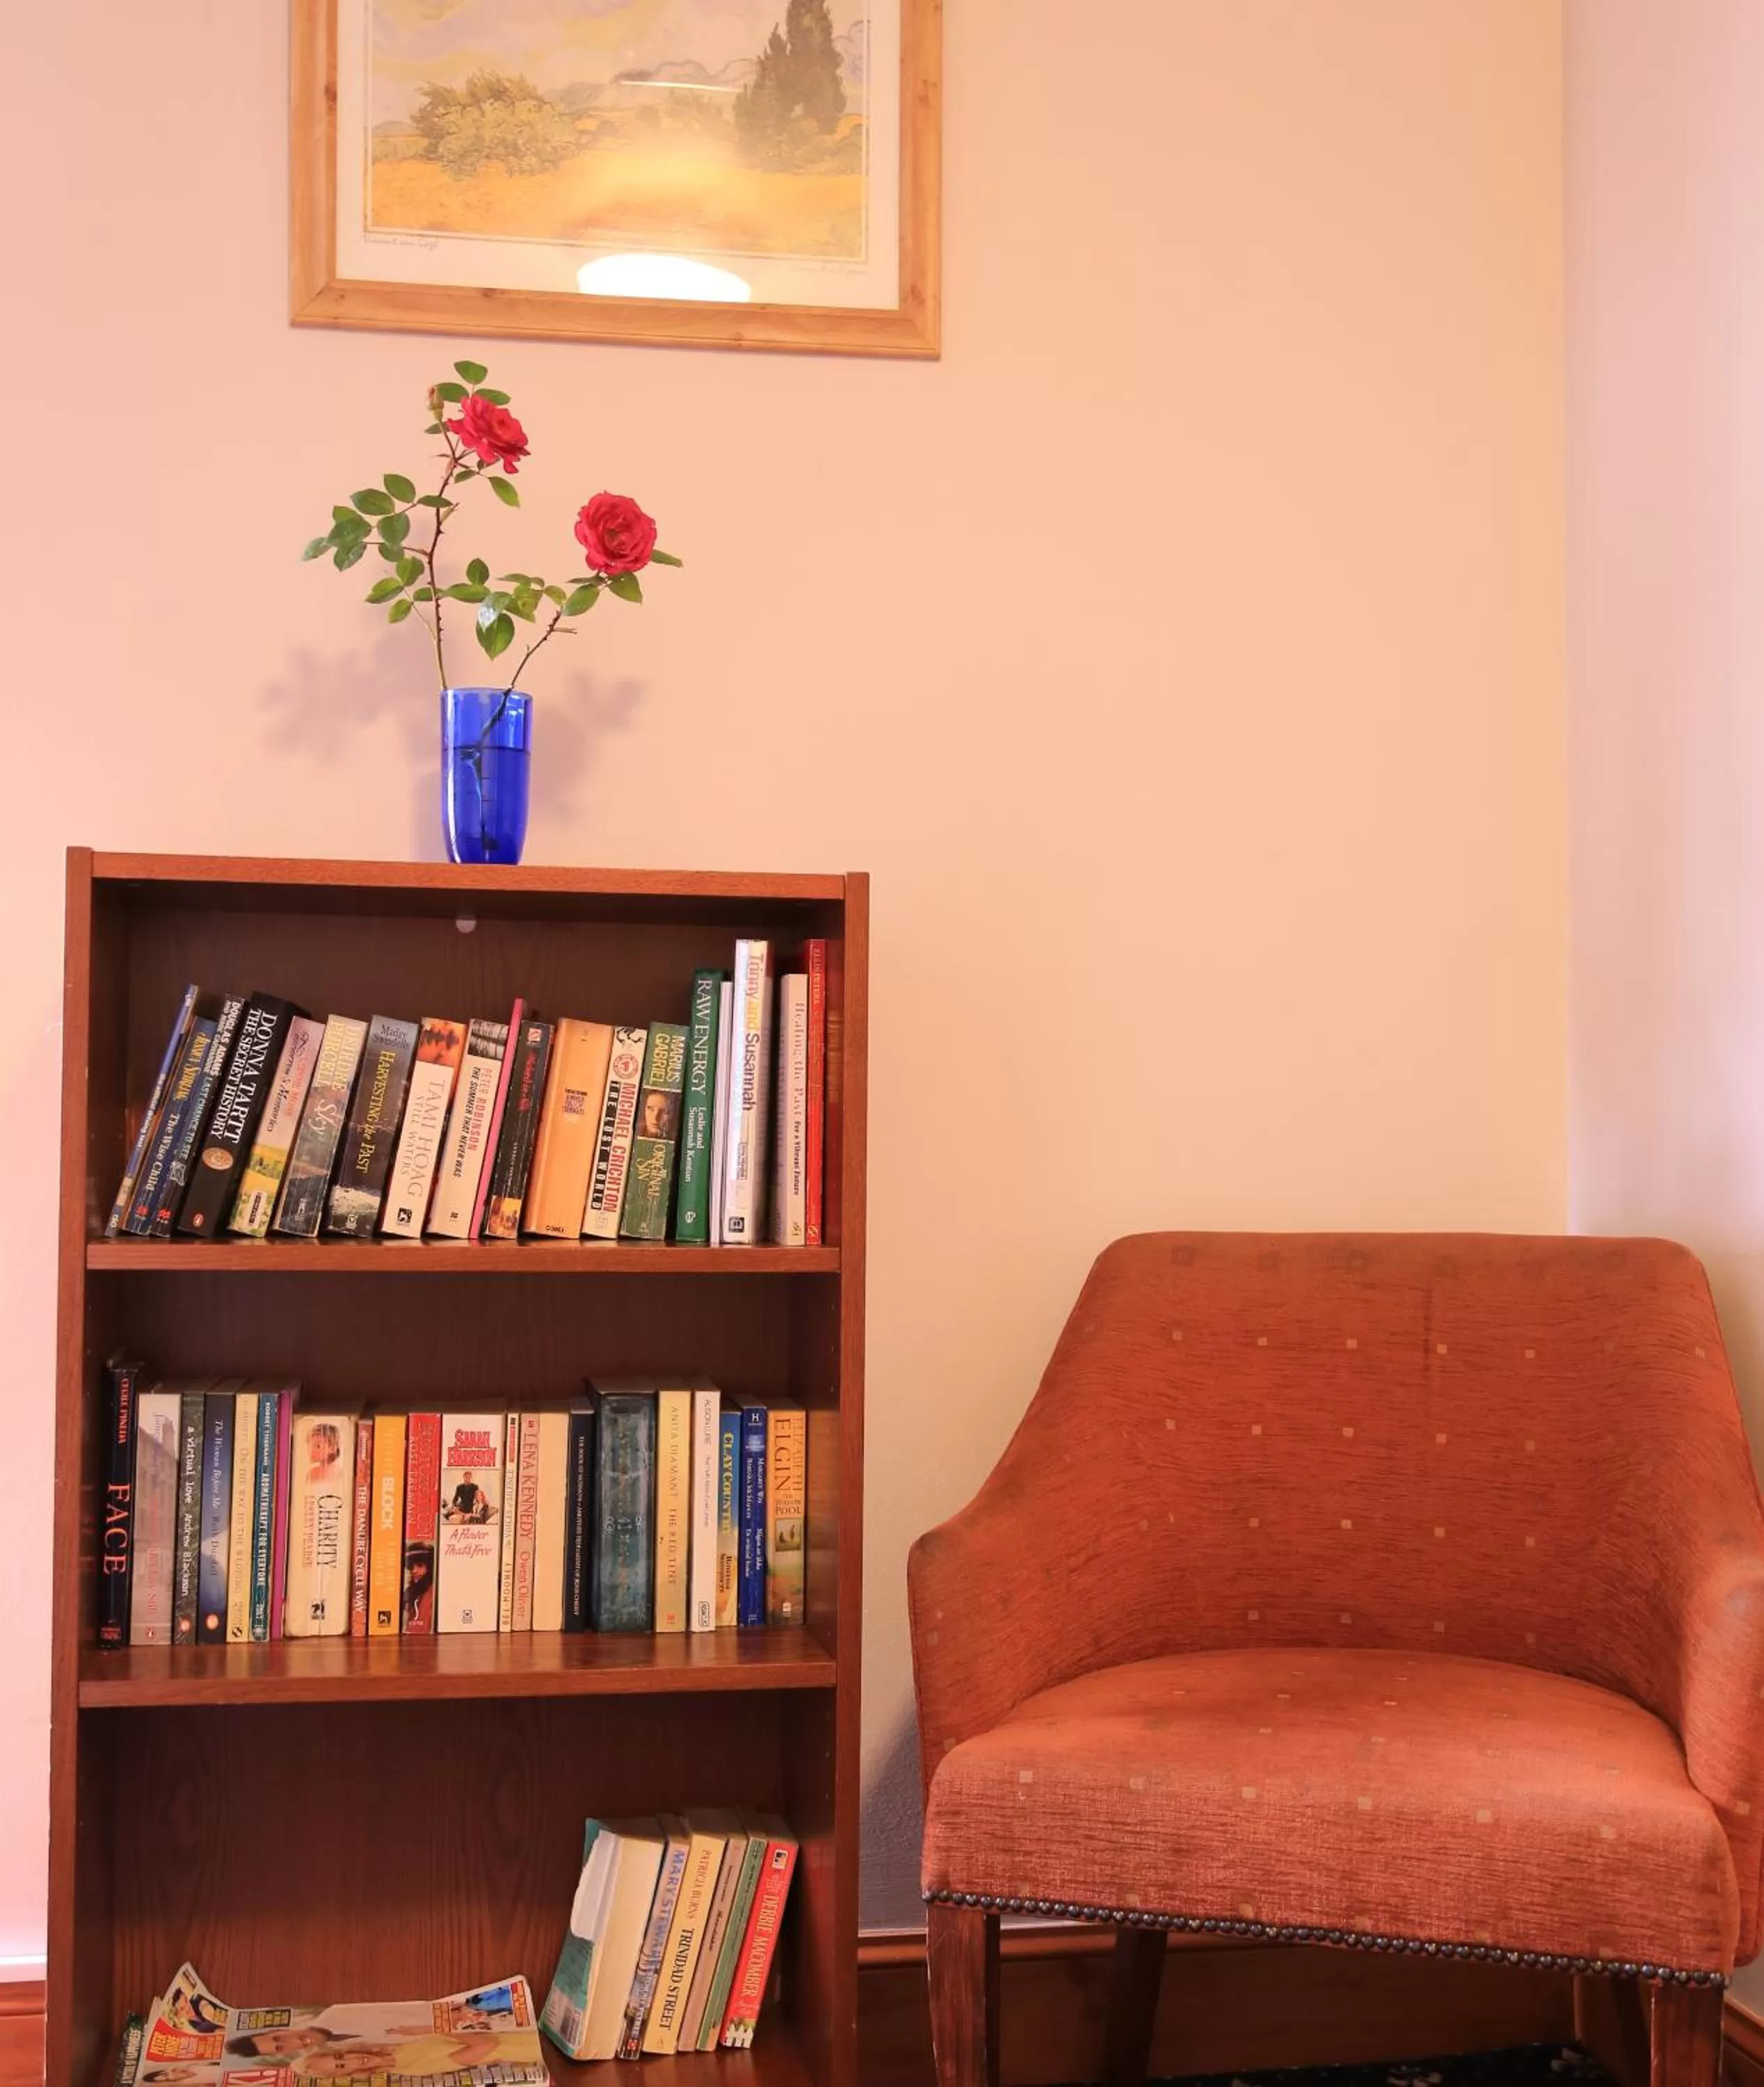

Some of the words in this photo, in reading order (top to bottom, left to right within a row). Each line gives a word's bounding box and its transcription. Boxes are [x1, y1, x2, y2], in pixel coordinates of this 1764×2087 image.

[746, 954, 765, 1000] Trinny
[697, 979, 714, 1017] RAW
[220, 1001, 241, 1044] DOUGLAS
[247, 1008, 262, 1036] THE
[745, 1000, 761, 1031] and
[793, 1002, 805, 1057] Healing
[210, 1045, 227, 1076] ADAMS
[227, 1034, 253, 1085] SECRET
[243, 1011, 278, 1077] DONNA
[314, 1020, 346, 1089] PURCELL
[332, 1025, 360, 1092] DEIRDRE
[650, 1032, 671, 1087] GABRIEL
[666, 1034, 686, 1083] MARIUS
[691, 1022, 711, 1097] ENERGY
[200, 1076, 212, 1097] LAST
[368, 1050, 396, 1125] HARVESTING
[472, 1066, 481, 1081] THE
[480, 1067, 493, 1098] PETER
[741, 1032, 760, 1112] Susannah
[794, 1060, 805, 1082] the
[211, 1085, 236, 1140] HISTORY
[223, 1082, 257, 1144] TARTT
[266, 1083, 291, 1133] Memories
[410, 1096, 424, 1125] STILL
[422, 1079, 447, 1130] TAMI
[465, 1082, 479, 1114] SUMMER
[607, 1080, 621, 1112] THE
[614, 1082, 636, 1140] MICHAEL
[792, 1089, 805, 1119] Past
[167, 1113, 180, 1133] The
[189, 1098, 206, 1130] CHANCE
[308, 1098, 343, 1135] Sky
[461, 1114, 472, 1135] THAT
[468, 1098, 487, 1151] ROBINSON
[686, 1106, 698, 1148] Susannah
[696, 1107, 707, 1131] Leslie
[156, 1135, 173, 1160] Wise
[184, 1131, 195, 1143] TO
[362, 1124, 376, 1141] the
[456, 1136, 467, 1160] NEVER
[598, 1116, 615, 1153] LOST
[695, 1131, 705, 1149] and
[179, 1146, 191, 1160] SEE
[355, 1142, 376, 1174] PAST
[401, 1130, 418, 1176] WATERS
[406, 1134, 433, 1197] HOAG
[453, 1160, 463, 1178] WAS
[636, 1158, 650, 1182] SIN
[648, 1143, 666, 1197] ORIGINAL
[684, 1149, 696, 1183] Kenton
[793, 1140, 802, 1167] Vibrant
[145, 1161, 163, 1190] Child
[591, 1159, 609, 1210] WORLD
[602, 1144, 627, 1213] CRICHTON
[792, 1169, 801, 1197] Future
[187, 1426, 195, 1438] a
[215, 1419, 224, 1434] The
[670, 1406, 679, 1439] ANITA
[751, 1413, 760, 1423] H
[408, 1437, 417, 1468] ROSE
[454, 1428, 492, 1449] SARAH
[522, 1432, 538, 1471] LENA
[721, 1432, 734, 1466] CLAY
[773, 1418, 792, 1492] ELGIN
[792, 1418, 803, 1492] ELIZABETH
[186, 1441, 196, 1479] virtual
[669, 1443, 679, 1498] DIAMANT
[184, 1481, 194, 1504] love
[358, 1485, 369, 1505] THE
[380, 1476, 396, 1530] BLOCK
[519, 1476, 538, 1543] KENNEDY
[721, 1466, 734, 1536] COUNTRY
[239, 1510, 246, 1524] TO
[668, 1508, 677, 1528] THE
[774, 1505, 803, 1515] POOL
[103, 1482, 132, 1575] FACE
[183, 1513, 194, 1549] Andrew
[258, 1532, 268, 1546] FOR
[316, 1494, 343, 1569] CHARITY
[356, 1508, 368, 1553] DANUBE
[449, 1528, 459, 1540] A
[457, 1527, 490, 1542] Flower
[668, 1530, 677, 1553] RED
[257, 1548, 268, 1586] EVERYONE
[444, 1542, 473, 1558] That's
[470, 1542, 492, 1560] Free
[520, 1550, 531, 1583] Owen
[181, 1552, 192, 1597] Blackman
[355, 1555, 366, 1588] CYCLE
[353, 1589, 364, 1613] WAY
[517, 1583, 530, 1618] Oliver
[666, 1850, 686, 1896] MARY
[695, 1850, 712, 1888] PATRICIA
[686, 1889, 703, 1920] BURNS
[760, 1894, 780, 1934] DEBBIE
[671, 1927, 696, 1983] TRINIDAD
[740, 1935, 769, 1997] MACOMBER
[659, 1983, 680, 2031] STREET
